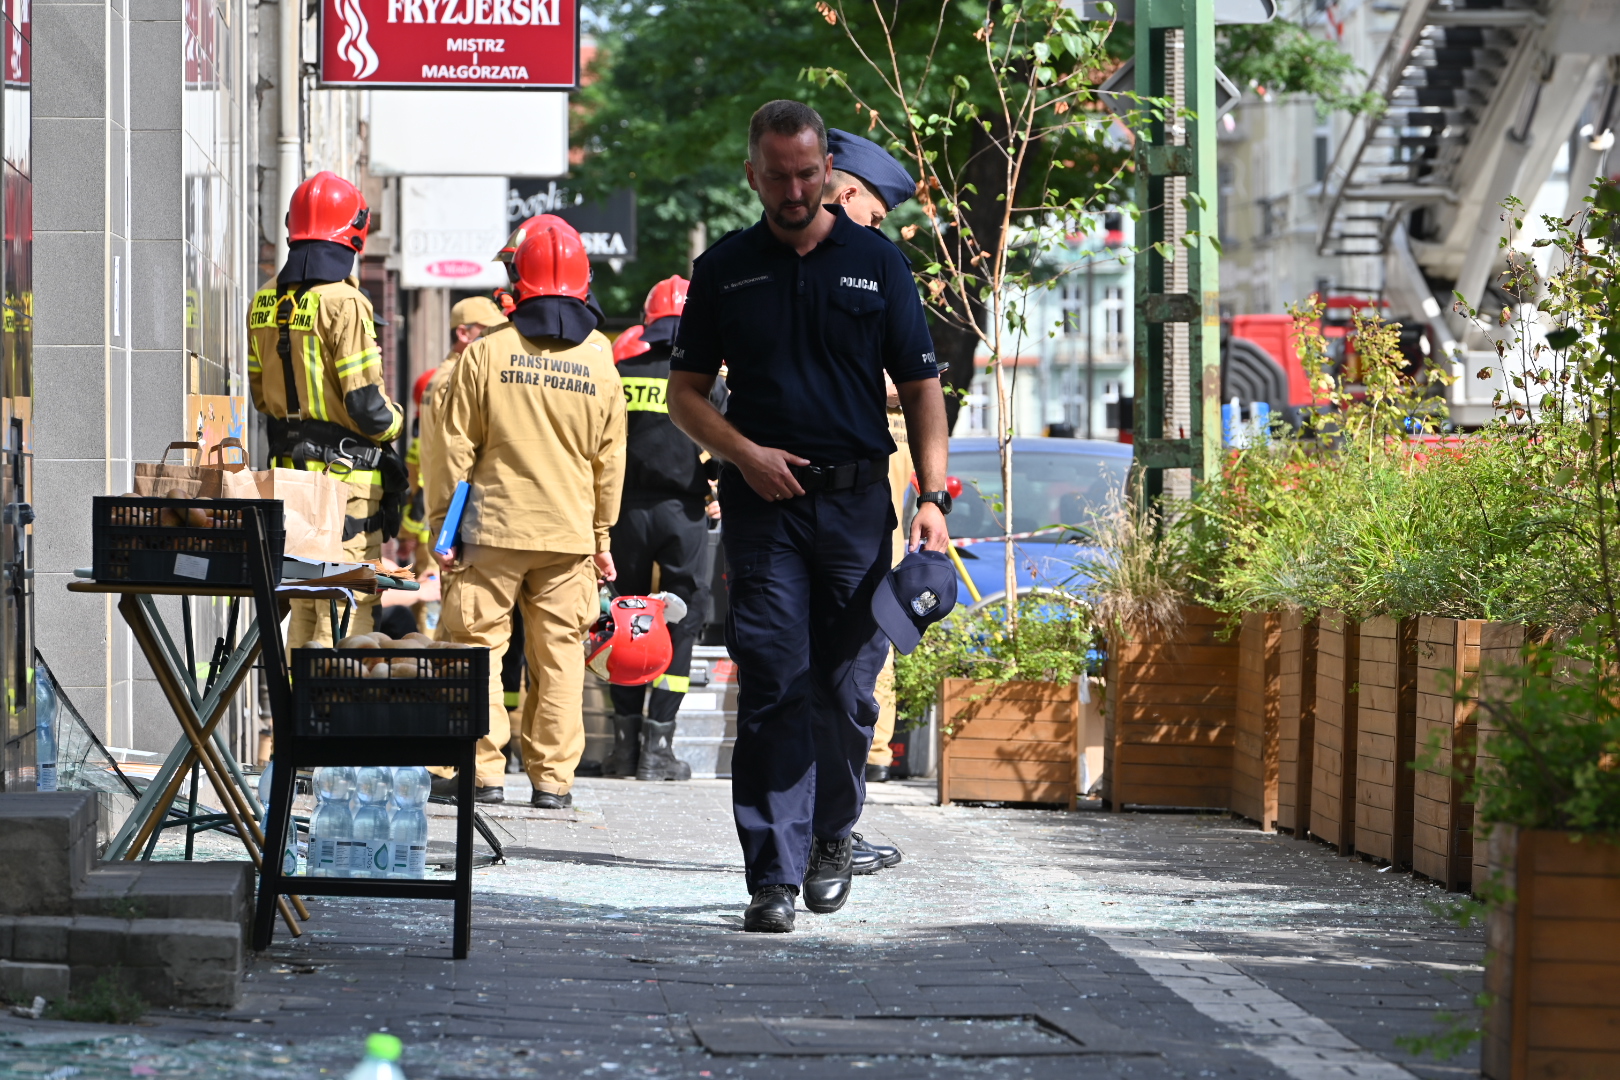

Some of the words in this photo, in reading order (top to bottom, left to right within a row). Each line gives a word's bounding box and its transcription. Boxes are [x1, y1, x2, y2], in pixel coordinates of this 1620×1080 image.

[387, 0, 560, 26] FRYZJERSKI
[446, 38, 505, 53] MISTRZ
[421, 64, 529, 80] MAŁGORZATA
[840, 276, 879, 293] POLICJA
[510, 353, 590, 378] PAŃSTWOWA
[500, 370, 540, 386] STRAŻ
[543, 374, 596, 397] POŻARNA
